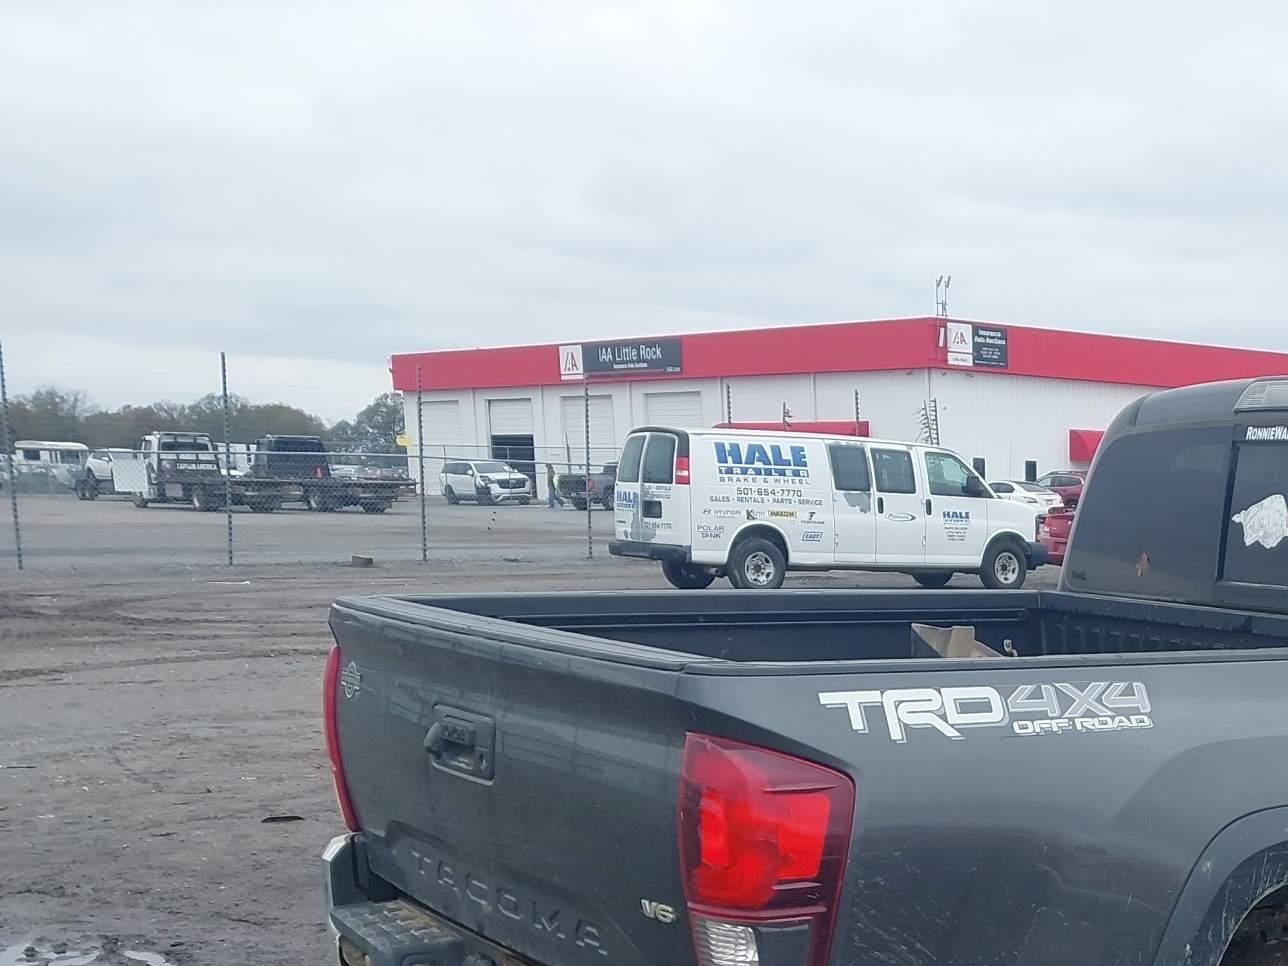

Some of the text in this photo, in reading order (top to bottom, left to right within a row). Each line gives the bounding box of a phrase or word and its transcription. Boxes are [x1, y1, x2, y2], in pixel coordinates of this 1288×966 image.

[598, 344, 662, 362] IAA Little Rock
[714, 441, 808, 467] HALE
[719, 467, 808, 477] TRAILER
[773, 477, 811, 485] WHEEL
[736, 487, 803, 497] 501-654-7770
[736, 496, 765, 504] RENTALS
[943, 511, 970, 519] HALE
[818, 686, 1008, 744] TRD
[1013, 715, 1154, 736] OFF ROAD
[409, 848, 609, 956] TACOMA
[640, 898, 677, 924] V6
